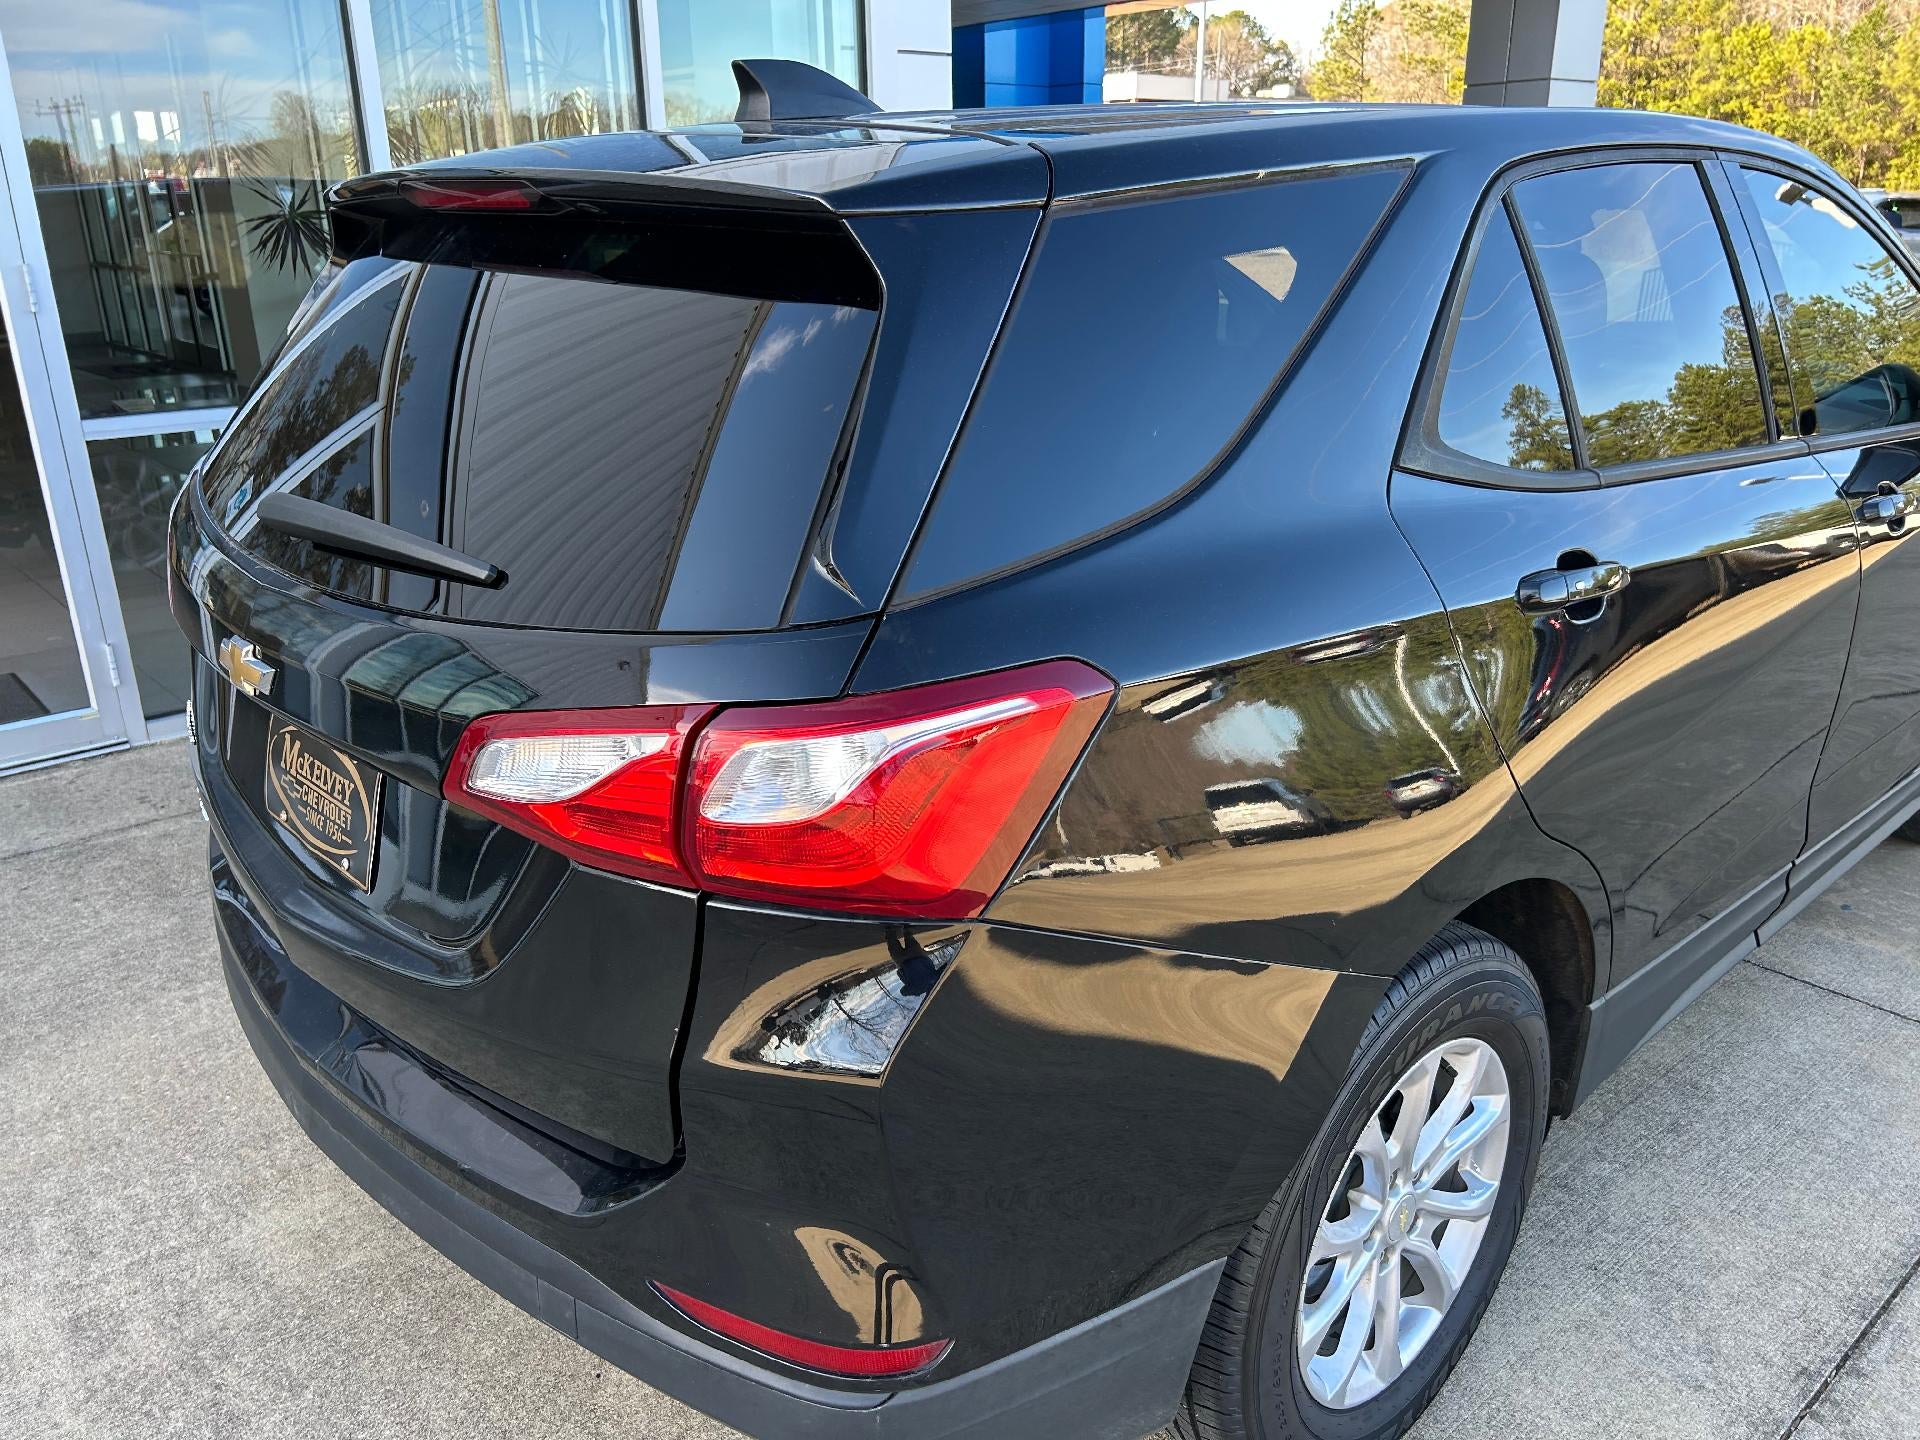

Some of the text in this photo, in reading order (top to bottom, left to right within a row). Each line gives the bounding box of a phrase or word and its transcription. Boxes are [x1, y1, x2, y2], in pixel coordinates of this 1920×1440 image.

[302, 784, 352, 831] CHEVROLET
[305, 806, 342, 843] SINCE 1956
